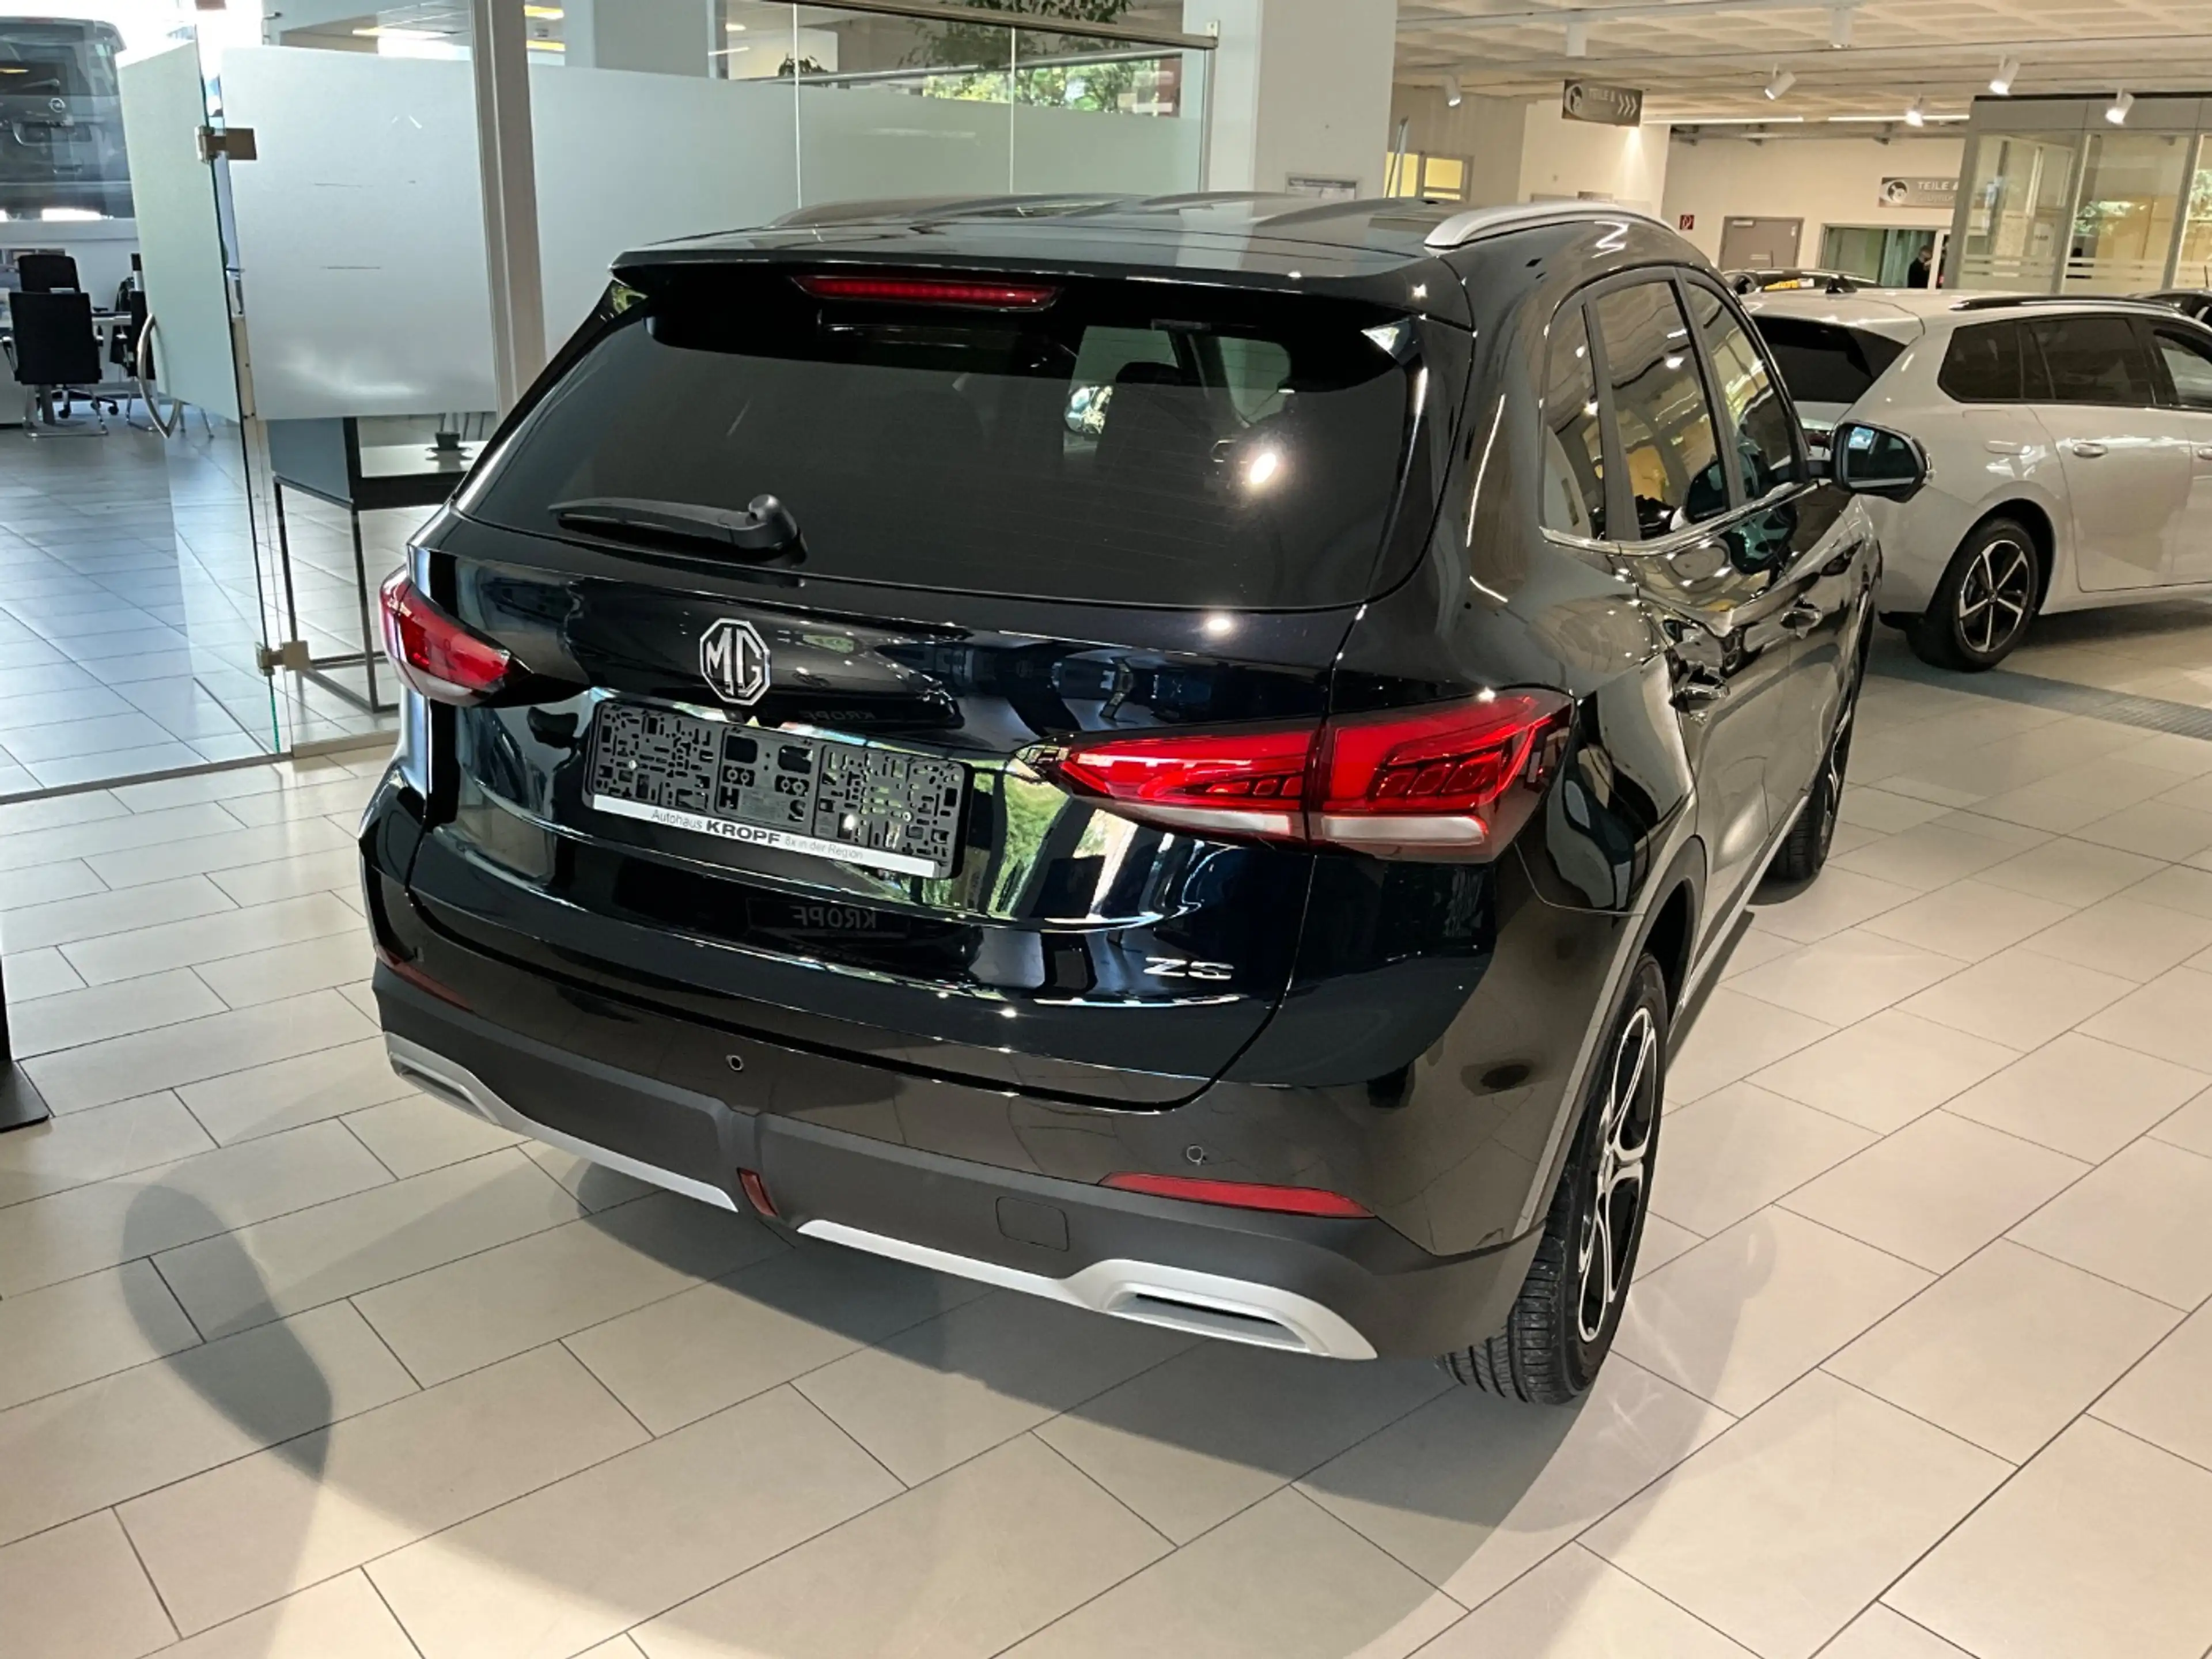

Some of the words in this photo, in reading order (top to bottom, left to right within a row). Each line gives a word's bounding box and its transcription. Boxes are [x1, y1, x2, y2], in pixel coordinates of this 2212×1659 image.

[1917, 181, 1949, 190] TEILE
[706, 627, 763, 697] MG
[651, 809, 702, 830] Autohaus
[706, 820, 781, 844] KROPF
[810, 841, 825, 853] der
[828, 843, 863, 859] Region
[1143, 957, 1234, 980] ZS
